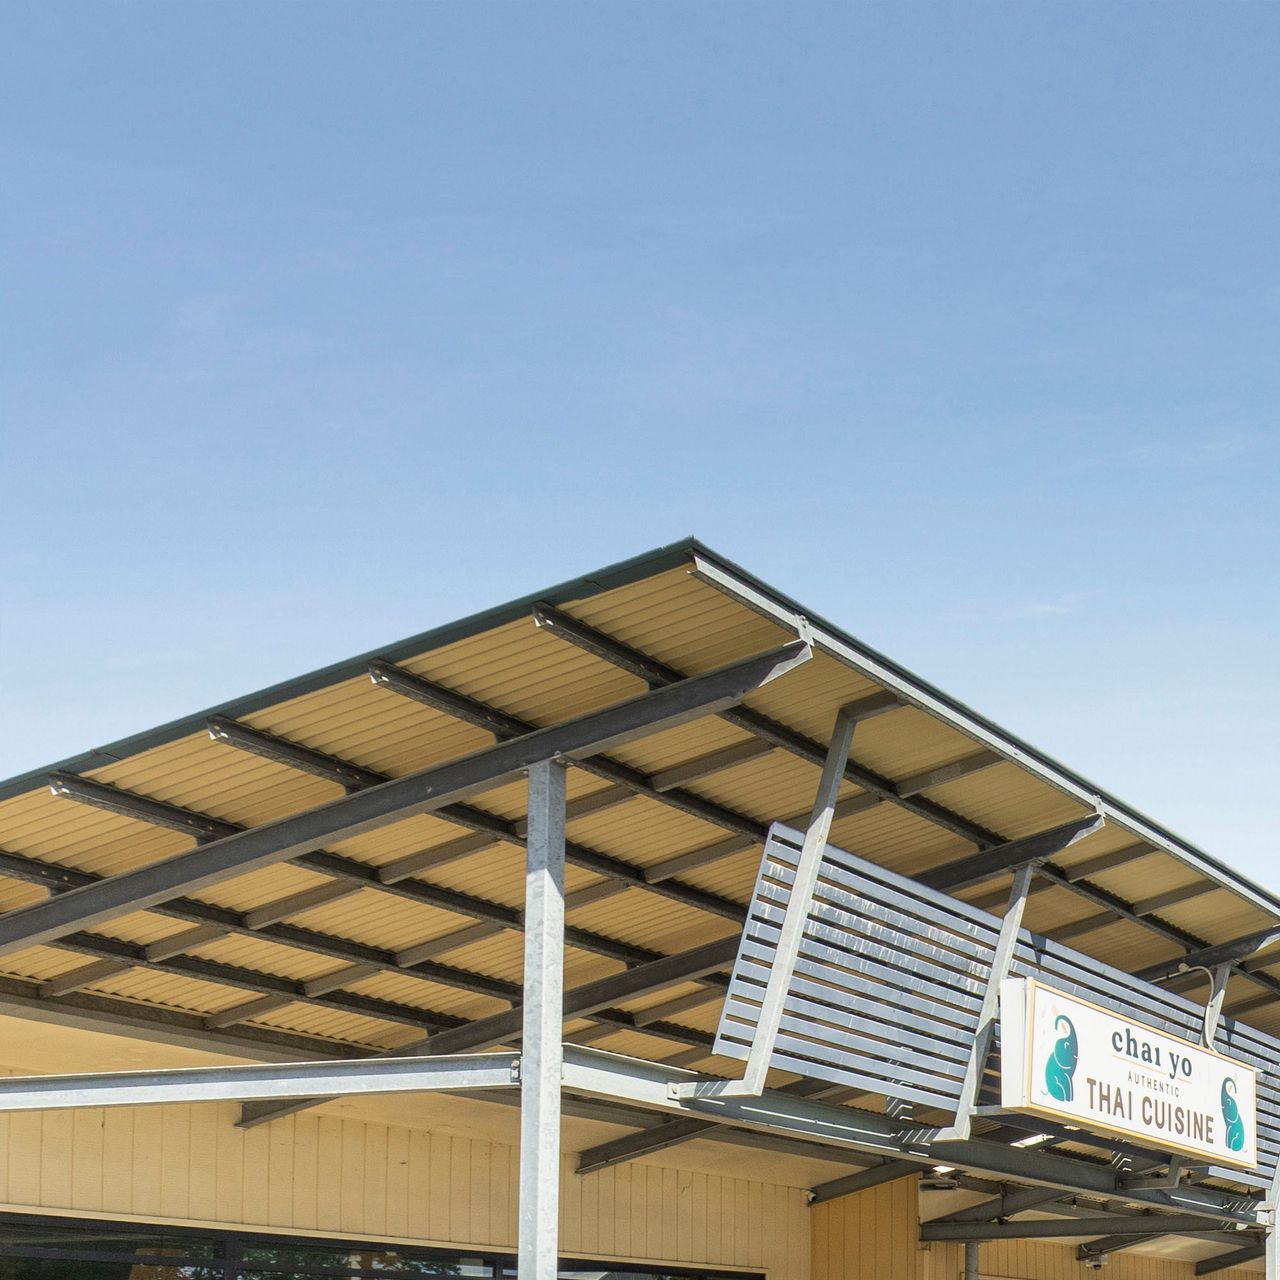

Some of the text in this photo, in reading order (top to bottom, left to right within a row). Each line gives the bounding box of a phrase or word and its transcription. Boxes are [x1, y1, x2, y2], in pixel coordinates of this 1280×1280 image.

[1112, 1028, 1193, 1079] chai yo
[1128, 1072, 1180, 1098] AUTHENTIC
[1086, 1077, 1214, 1145] THAI CUISINE
